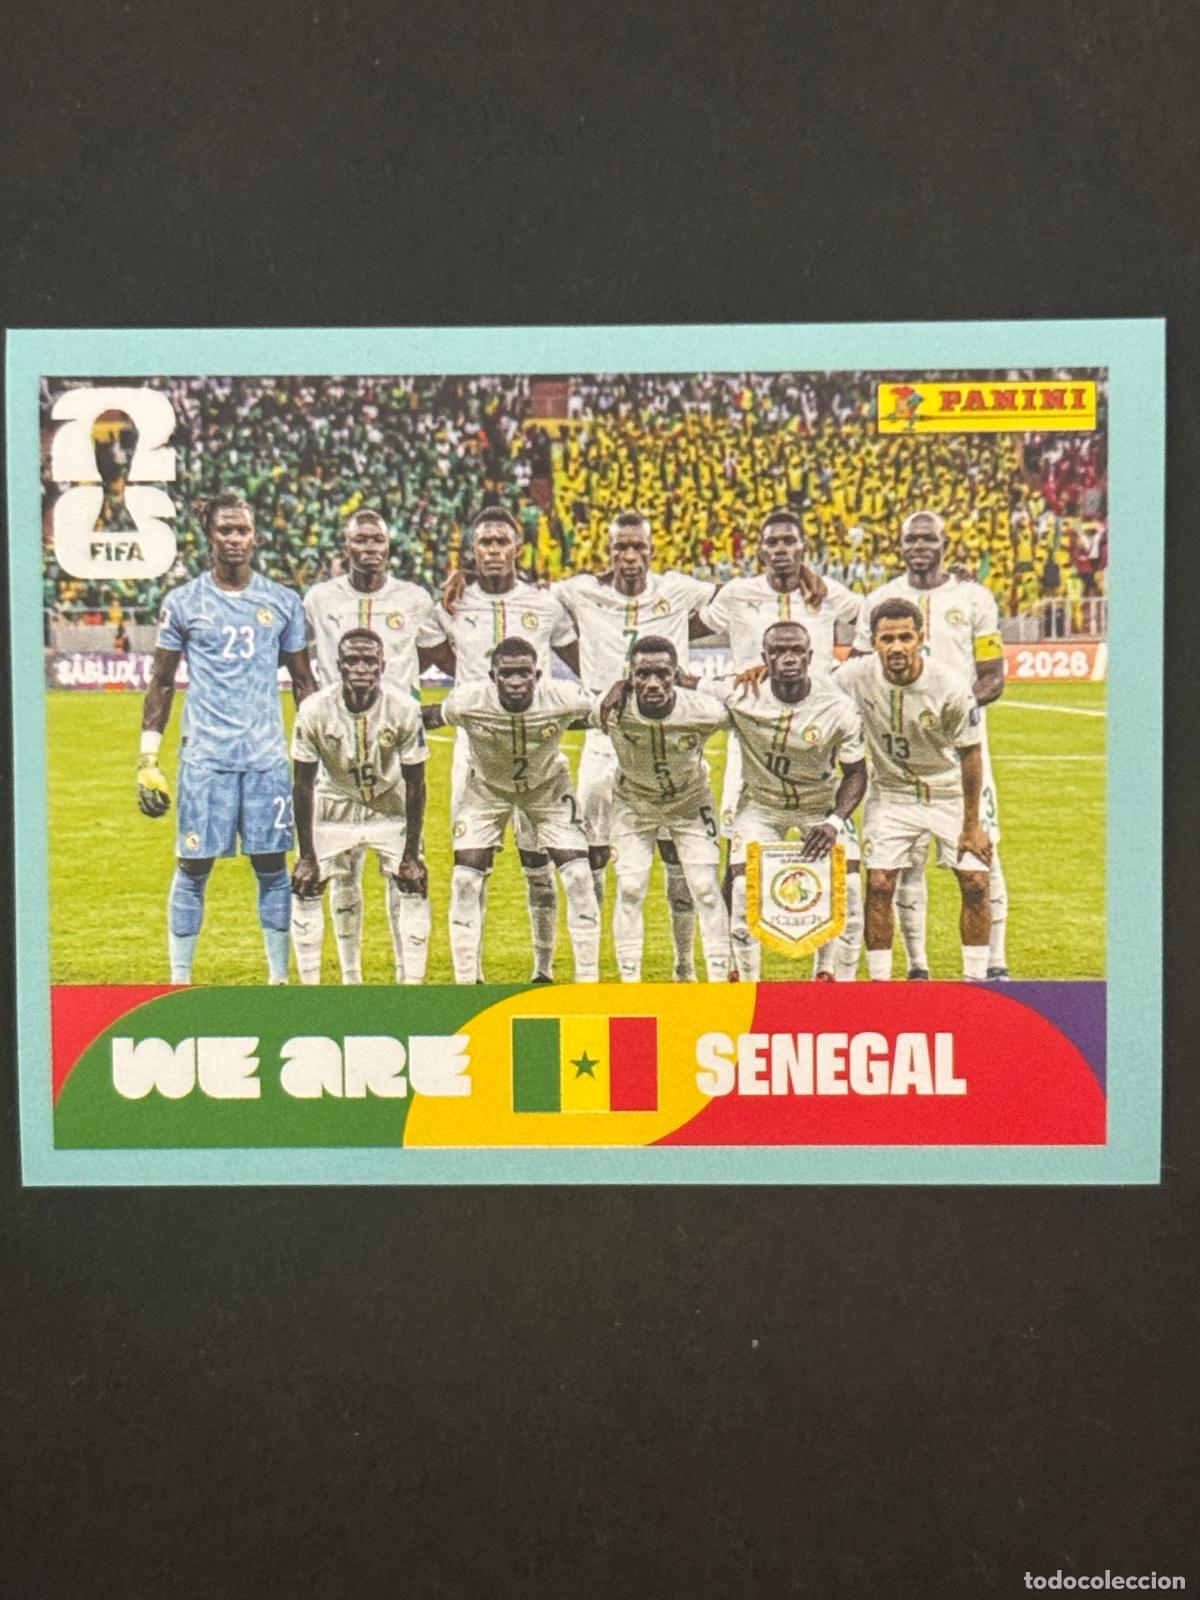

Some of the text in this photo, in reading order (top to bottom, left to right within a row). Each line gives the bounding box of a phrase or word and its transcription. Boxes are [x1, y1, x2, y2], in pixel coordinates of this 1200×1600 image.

[938, 388, 1087, 412] PANINI
[89, 541, 145, 562] FIFA
[221, 625, 256, 660] 23
[881, 733, 911, 760] 13
[512, 757, 528, 781] 2
[653, 762, 671, 781] 5
[765, 752, 791, 776] 10
[561, 794, 582, 824] 2
[699, 806, 717, 837] 5
[112, 1031, 968, 1099] WE ARE SENEGAL
